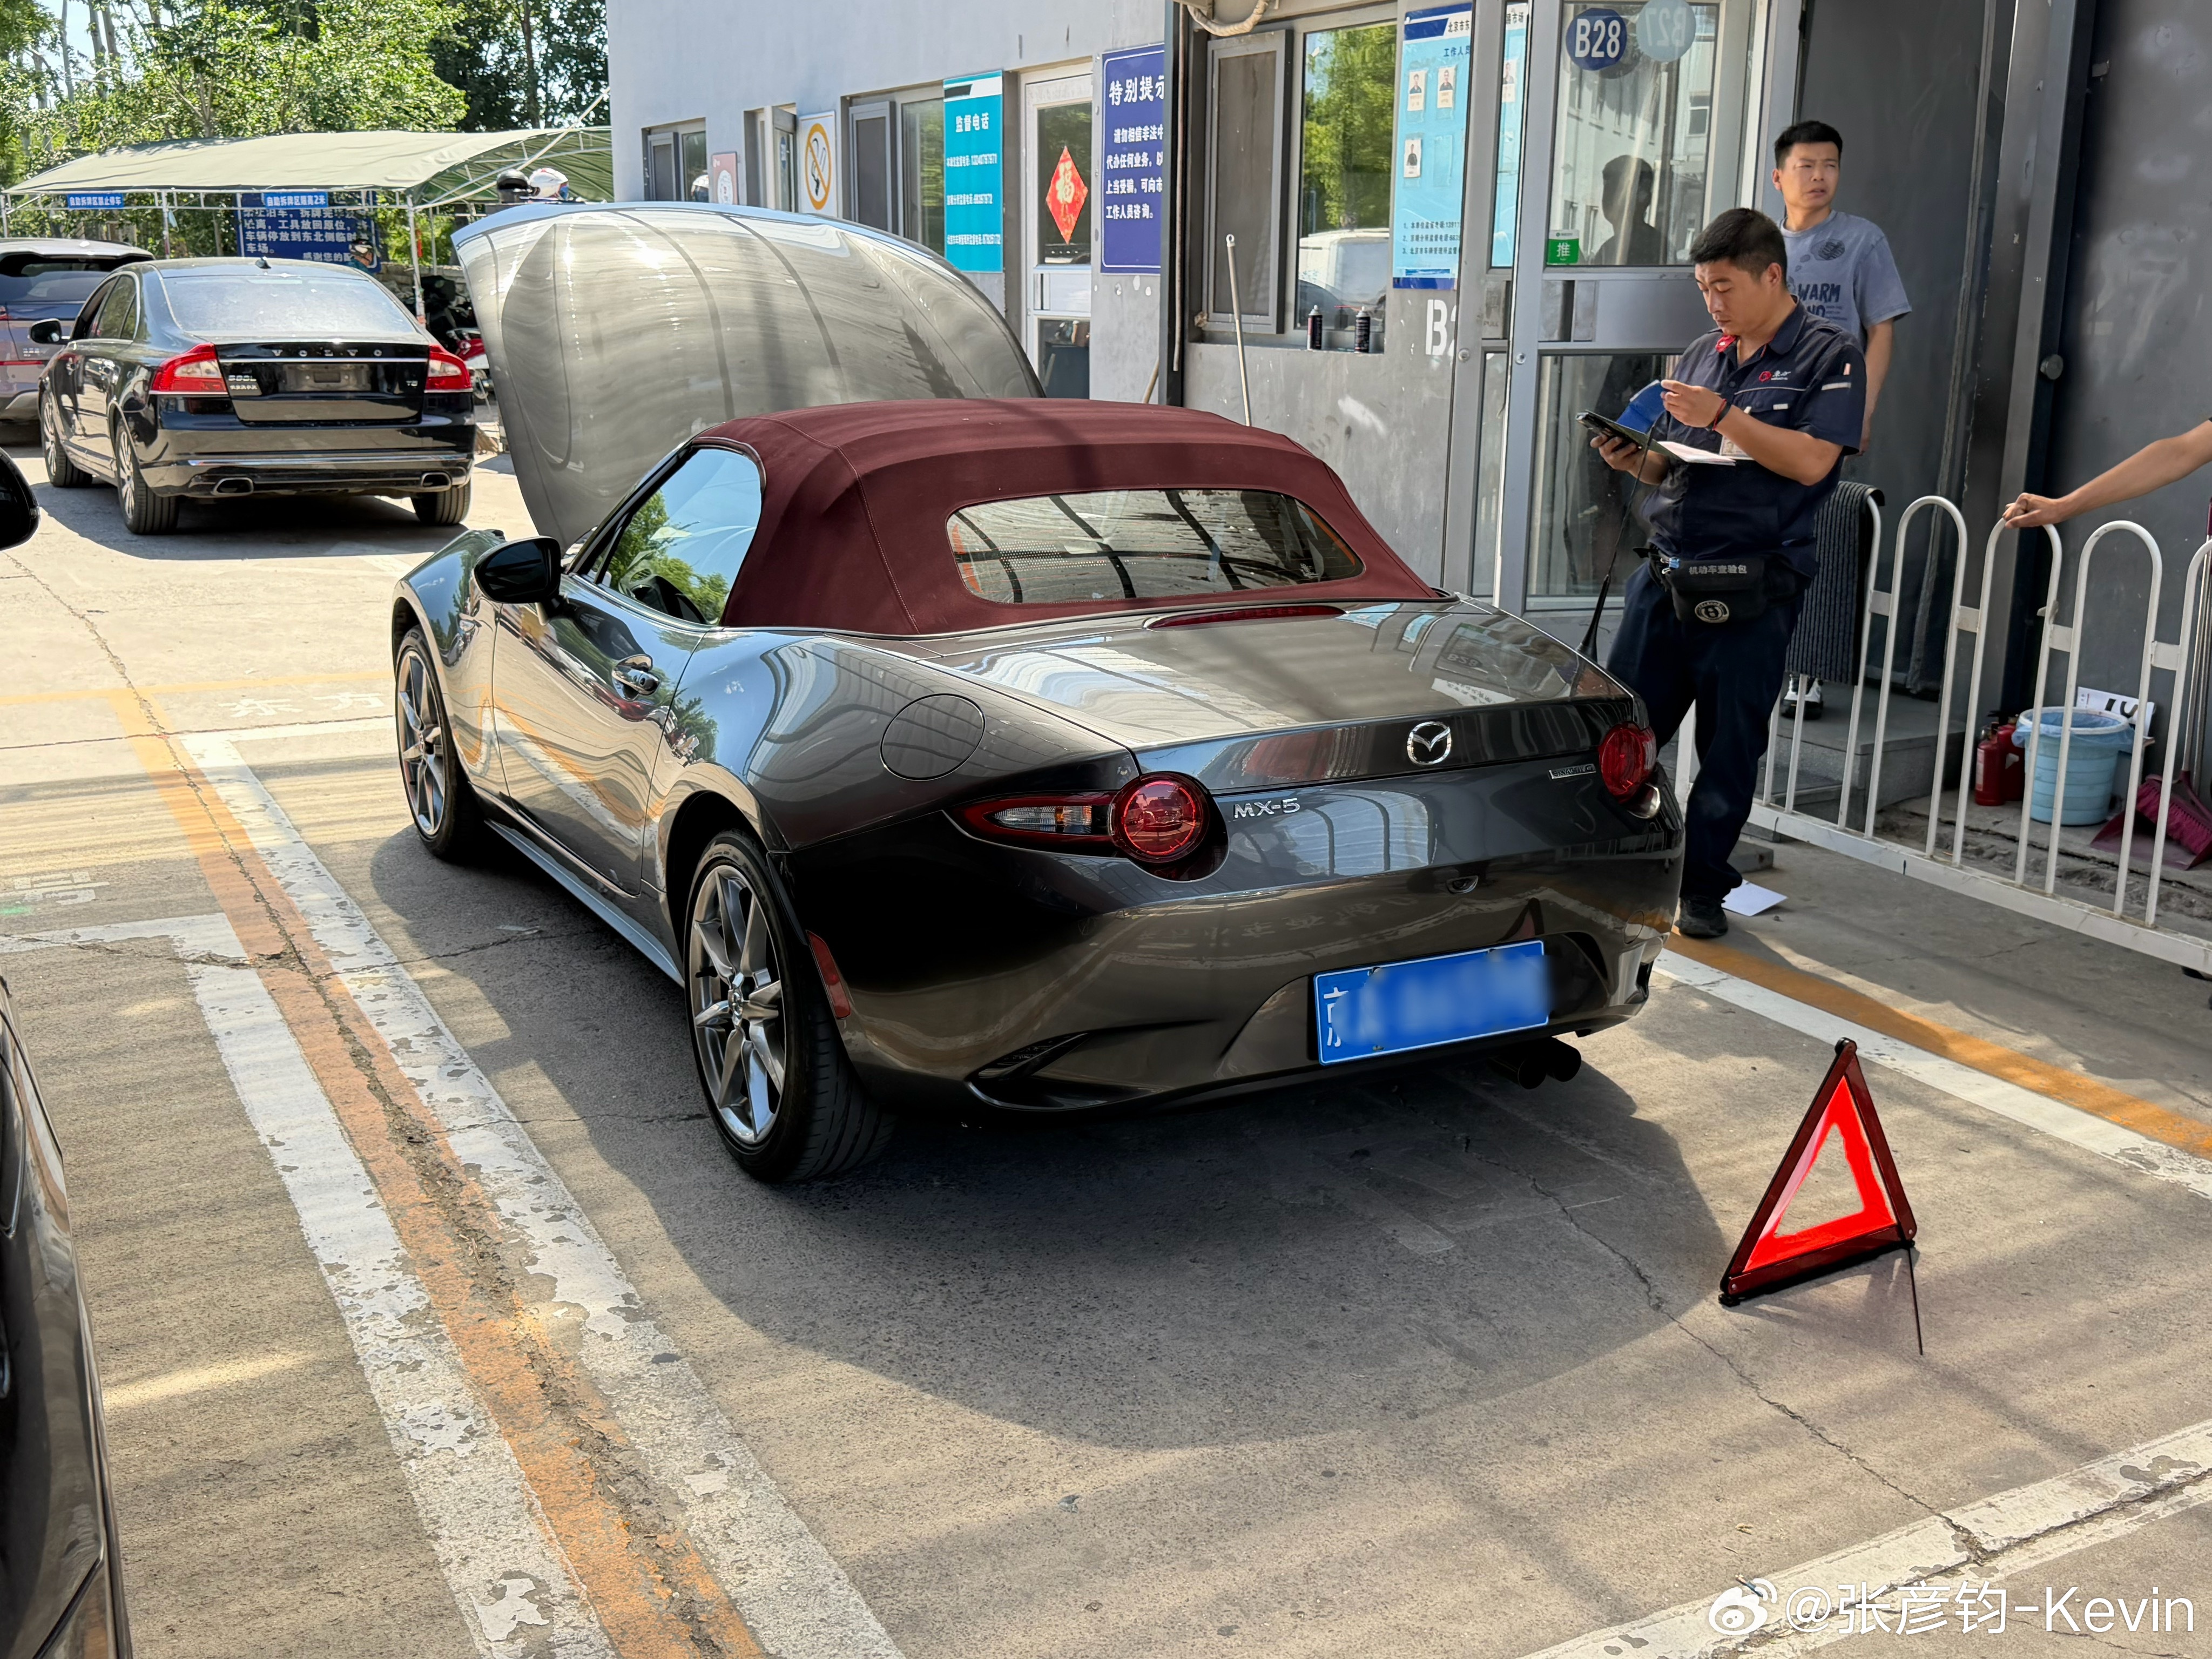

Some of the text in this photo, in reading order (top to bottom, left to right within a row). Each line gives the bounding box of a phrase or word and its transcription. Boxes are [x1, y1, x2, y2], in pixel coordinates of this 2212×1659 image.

[1575, 18, 1621, 58] B28
[1443, 45, 1471, 57] 工作人员
[1109, 75, 1164, 106] 特别提示
[955, 112, 989, 133] 监督电话
[1055, 161, 1075, 204] 福
[1556, 242, 1570, 257] 推
[1798, 283, 1840, 302] WARM
[1689, 564, 1748, 575] 机动车查验包
[1234, 798, 1300, 819] MX-5
